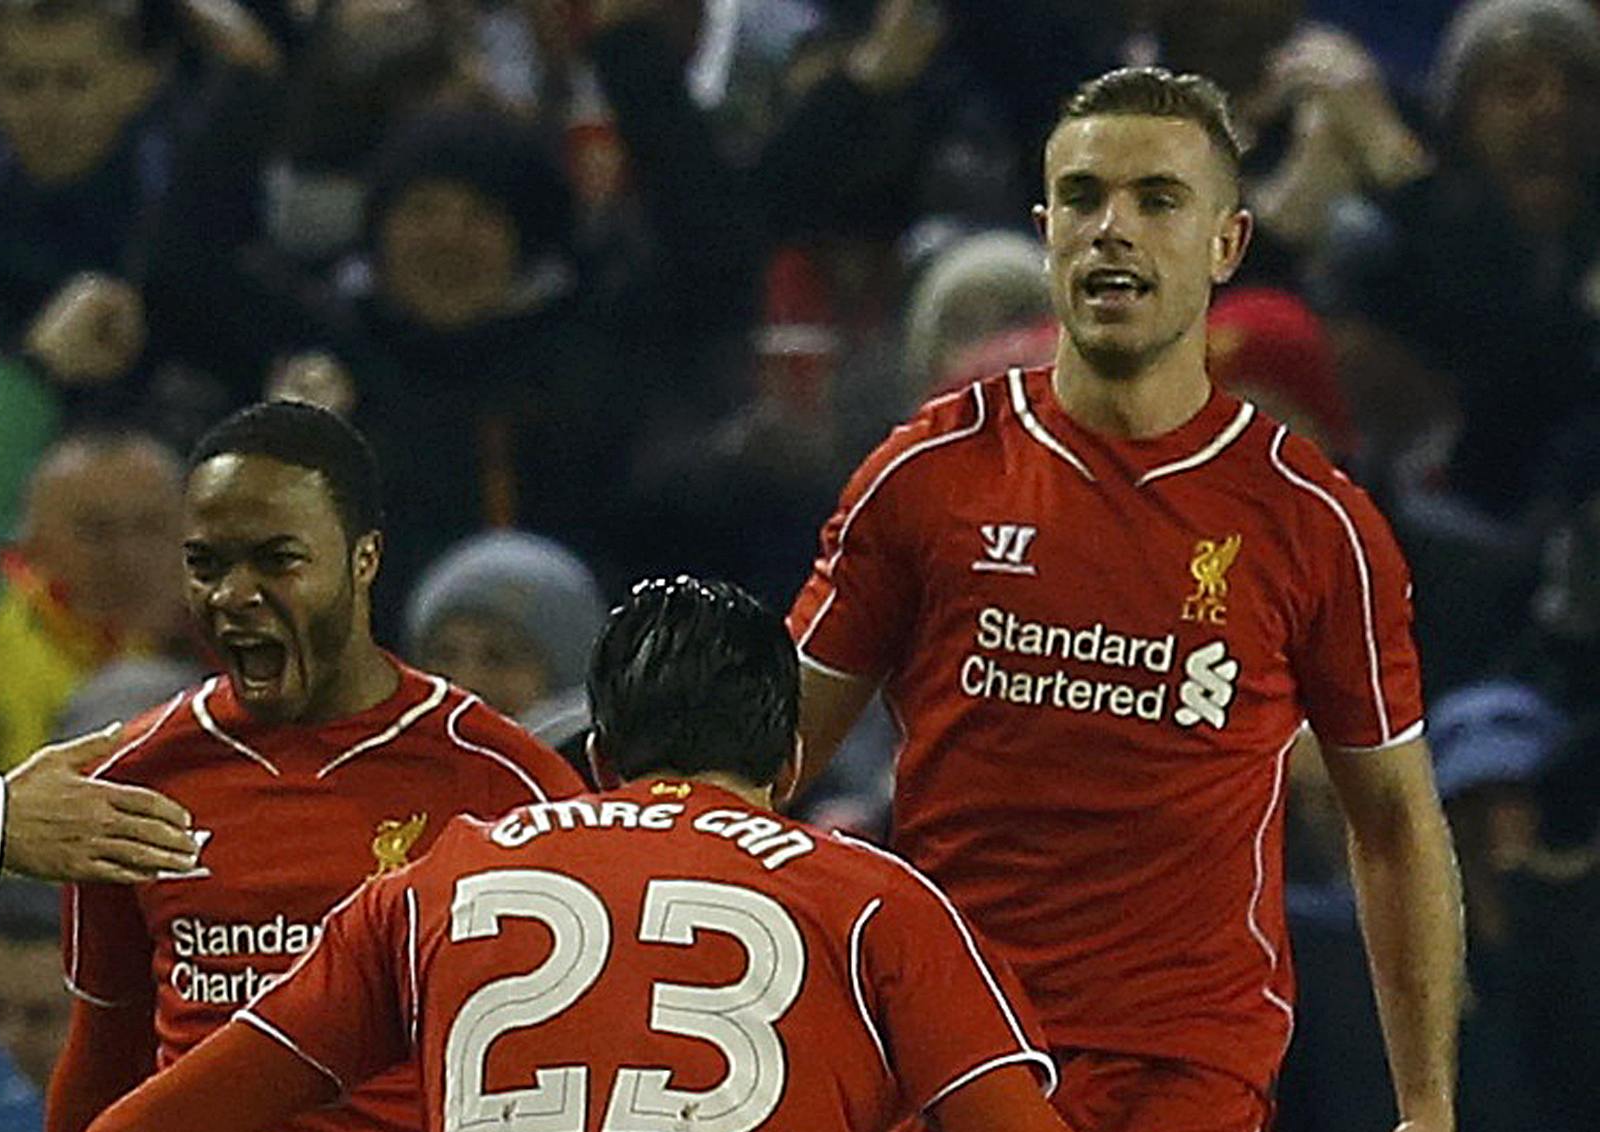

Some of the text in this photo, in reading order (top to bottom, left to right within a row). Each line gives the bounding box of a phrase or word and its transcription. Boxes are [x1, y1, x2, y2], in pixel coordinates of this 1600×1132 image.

[977, 607, 1175, 673] Standard
[960, 655, 1166, 721] Chartered
[490, 798, 816, 871] EMRE CAN
